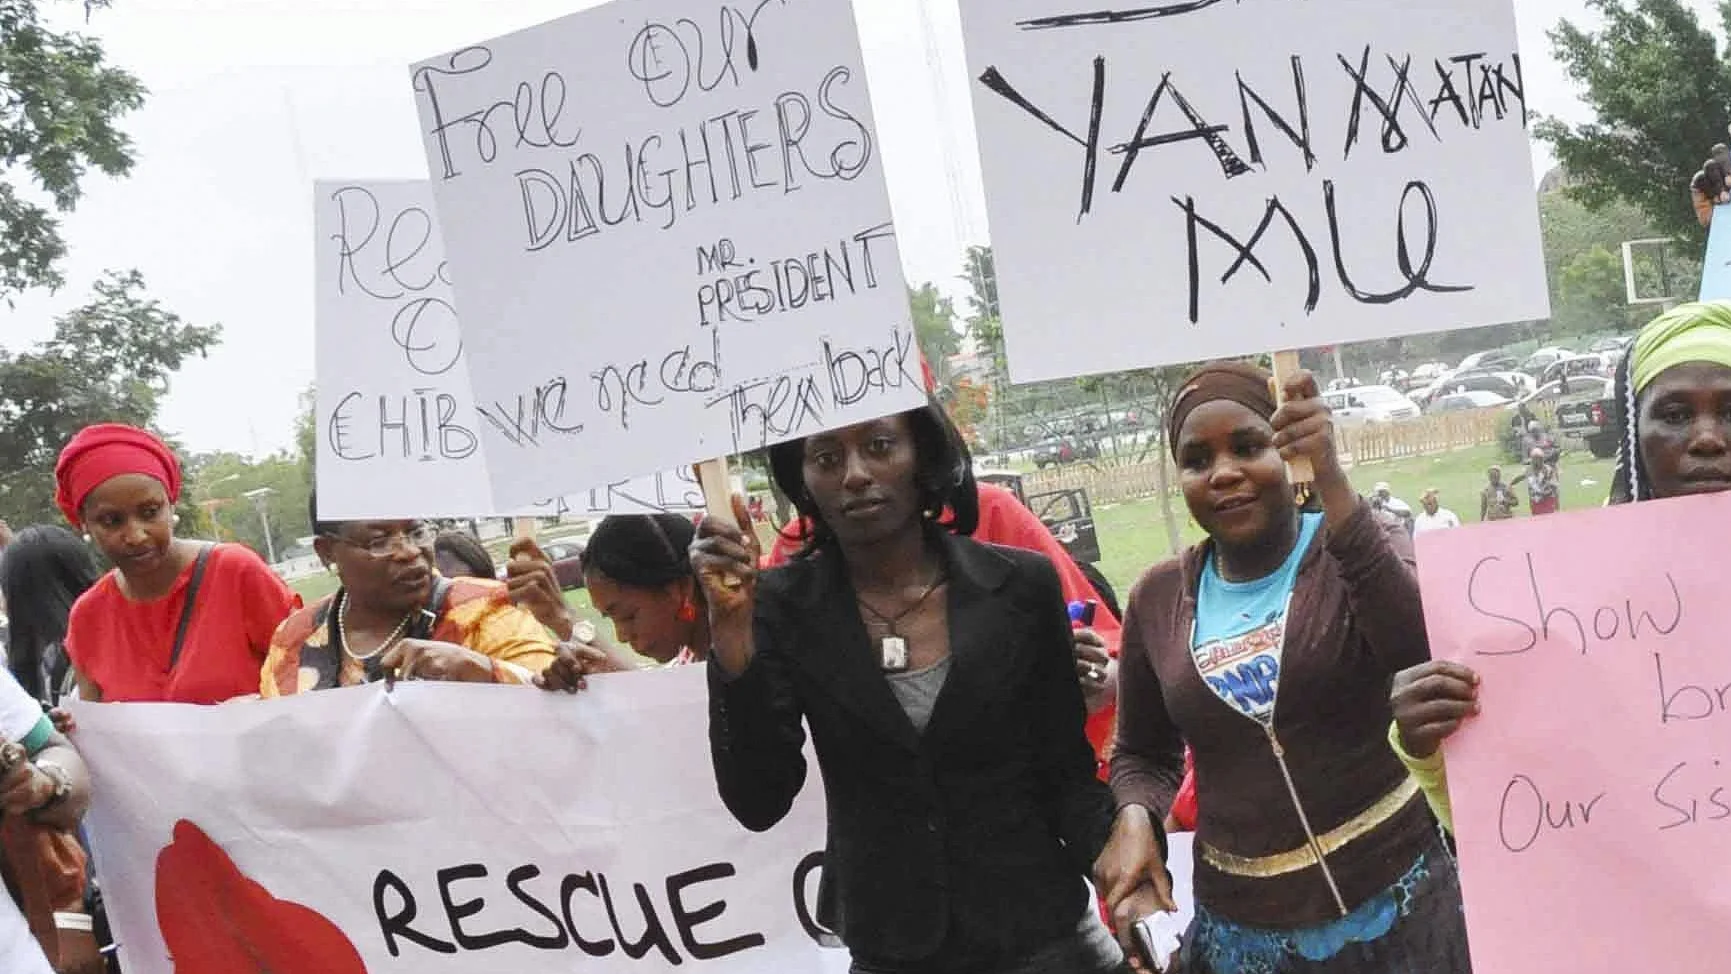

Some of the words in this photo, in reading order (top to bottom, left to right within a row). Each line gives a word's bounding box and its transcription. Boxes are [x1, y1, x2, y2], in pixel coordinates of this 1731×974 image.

[412, 46, 583, 179] Free
[515, 66, 872, 251] DAUGHTERS
[697, 239, 755, 273] MR.
[697, 222, 896, 328] PRESIDENT
[592, 327, 721, 430] need
[822, 326, 926, 409] back
[1467, 552, 1681, 656] Show
[1499, 774, 1608, 853] Our
[373, 862, 766, 966] RESCUE
